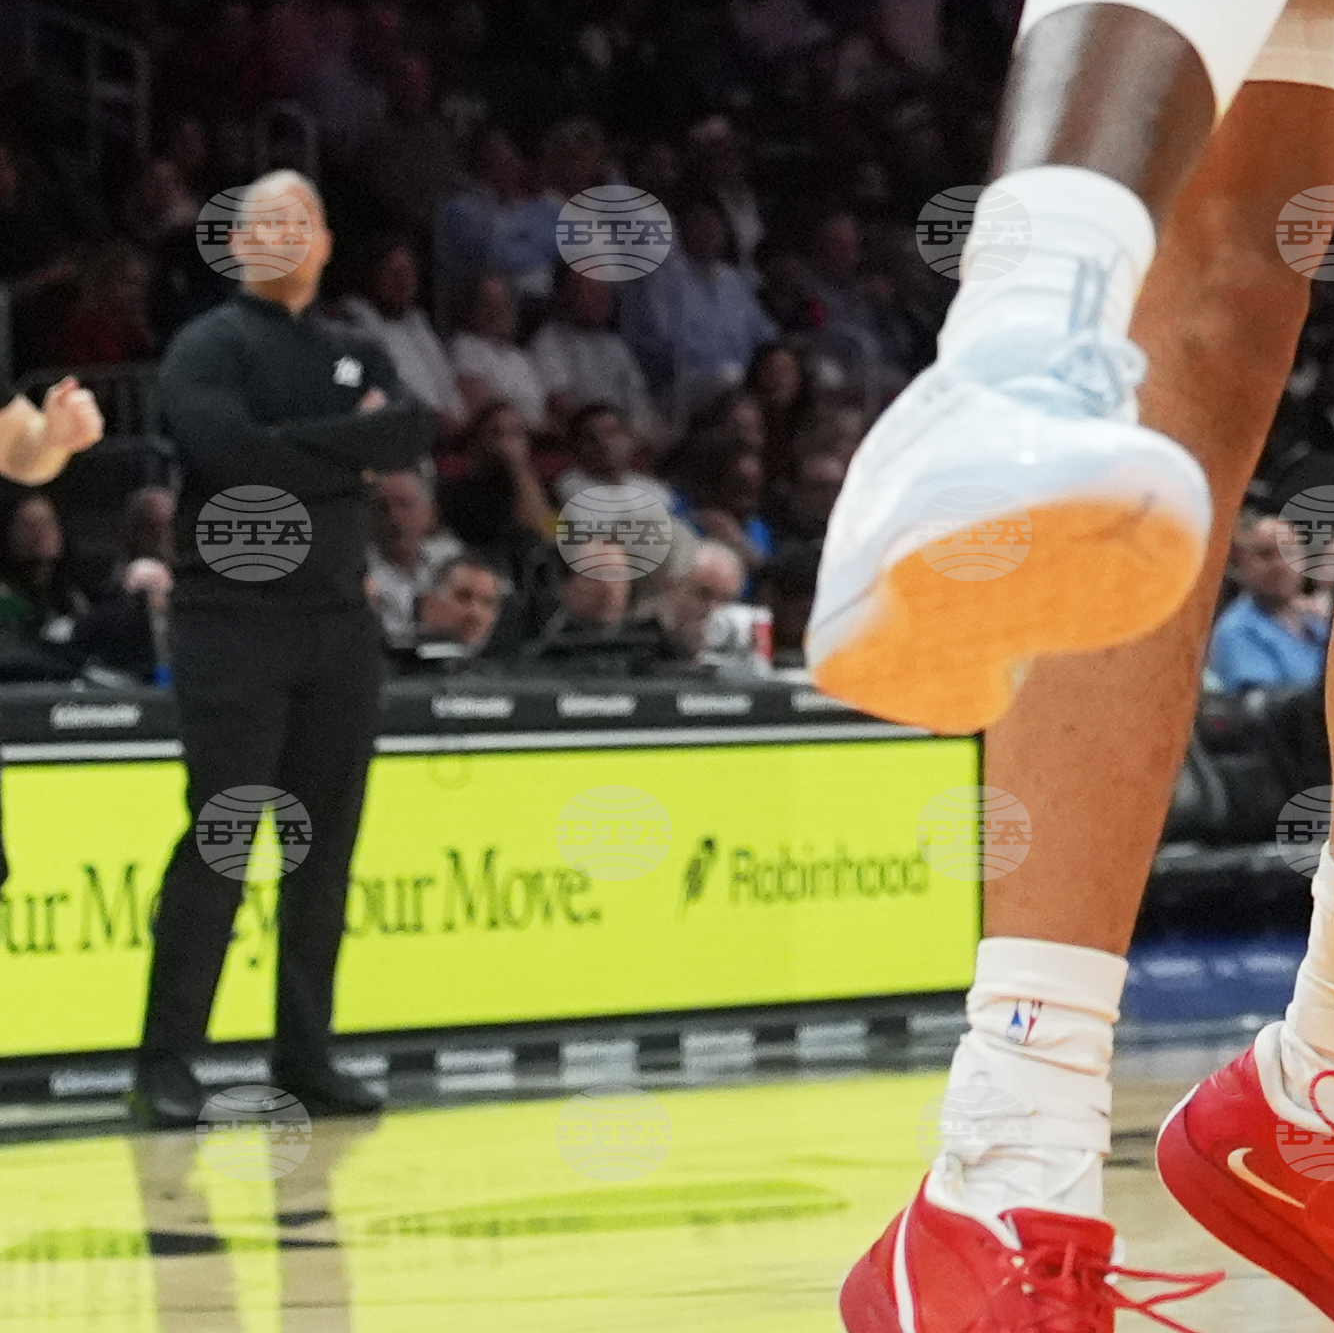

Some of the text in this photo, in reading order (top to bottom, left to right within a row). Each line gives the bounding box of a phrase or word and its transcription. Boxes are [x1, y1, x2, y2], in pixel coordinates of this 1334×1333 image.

[0, 891, 69, 954] ur
[442, 844, 602, 932] Move.
[729, 841, 930, 907] Robinhood
